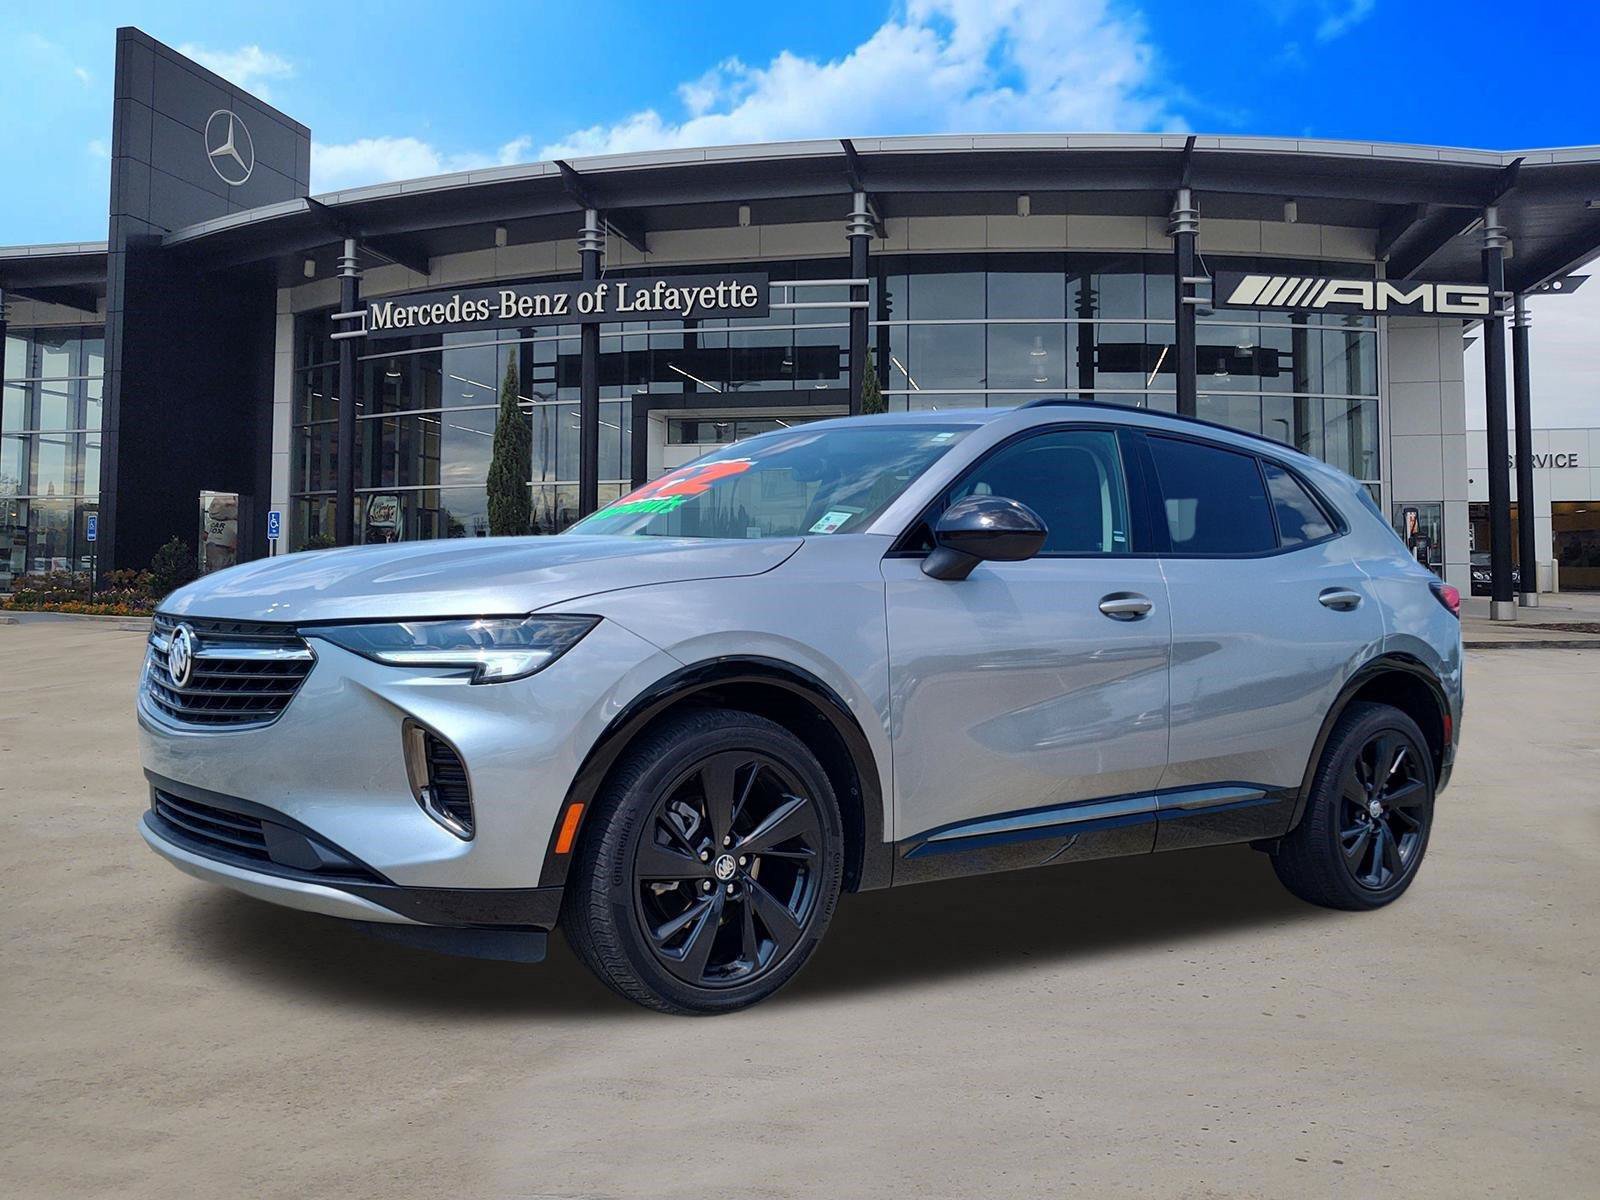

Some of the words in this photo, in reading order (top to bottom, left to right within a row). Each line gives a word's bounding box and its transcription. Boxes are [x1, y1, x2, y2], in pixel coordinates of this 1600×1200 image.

[369, 290, 569, 331] Mercedes-Benz
[577, 283, 608, 314] of
[616, 279, 758, 317] Lafayette
[1312, 279, 1490, 315] AMG
[1507, 453, 1578, 468] SRVICE
